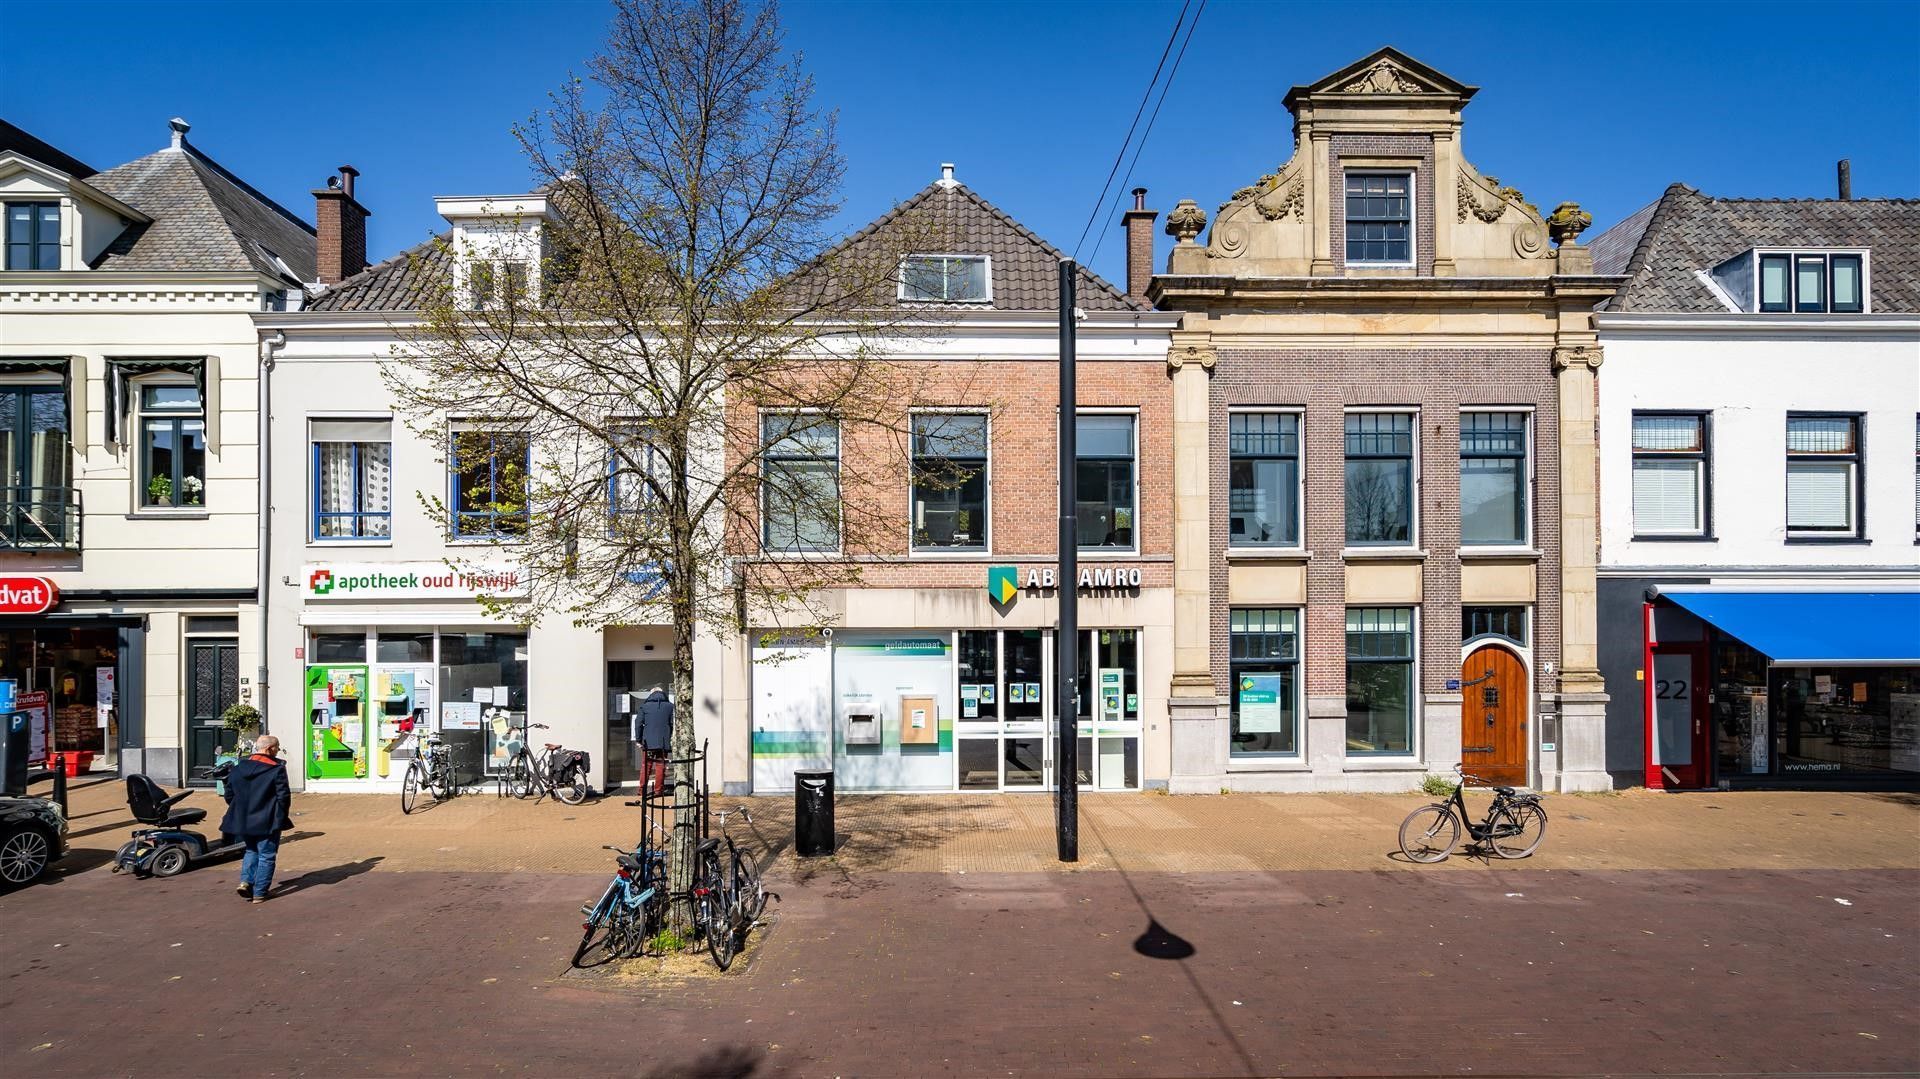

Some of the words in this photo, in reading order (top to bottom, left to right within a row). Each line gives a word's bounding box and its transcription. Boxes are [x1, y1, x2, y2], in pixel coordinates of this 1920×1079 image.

[339, 573, 418, 592] apotheek
[422, 573, 454, 588] oud
[459, 572, 519, 592] rijswijk
[1027, 568, 1060, 587] AB
[1079, 568, 1142, 587] AMRO
[884, 641, 941, 651] geldautomaat
[1656, 680, 1688, 700] 22
[12, 715, 22, 730] P
[1785, 763, 1841, 772] www.hema.nl
